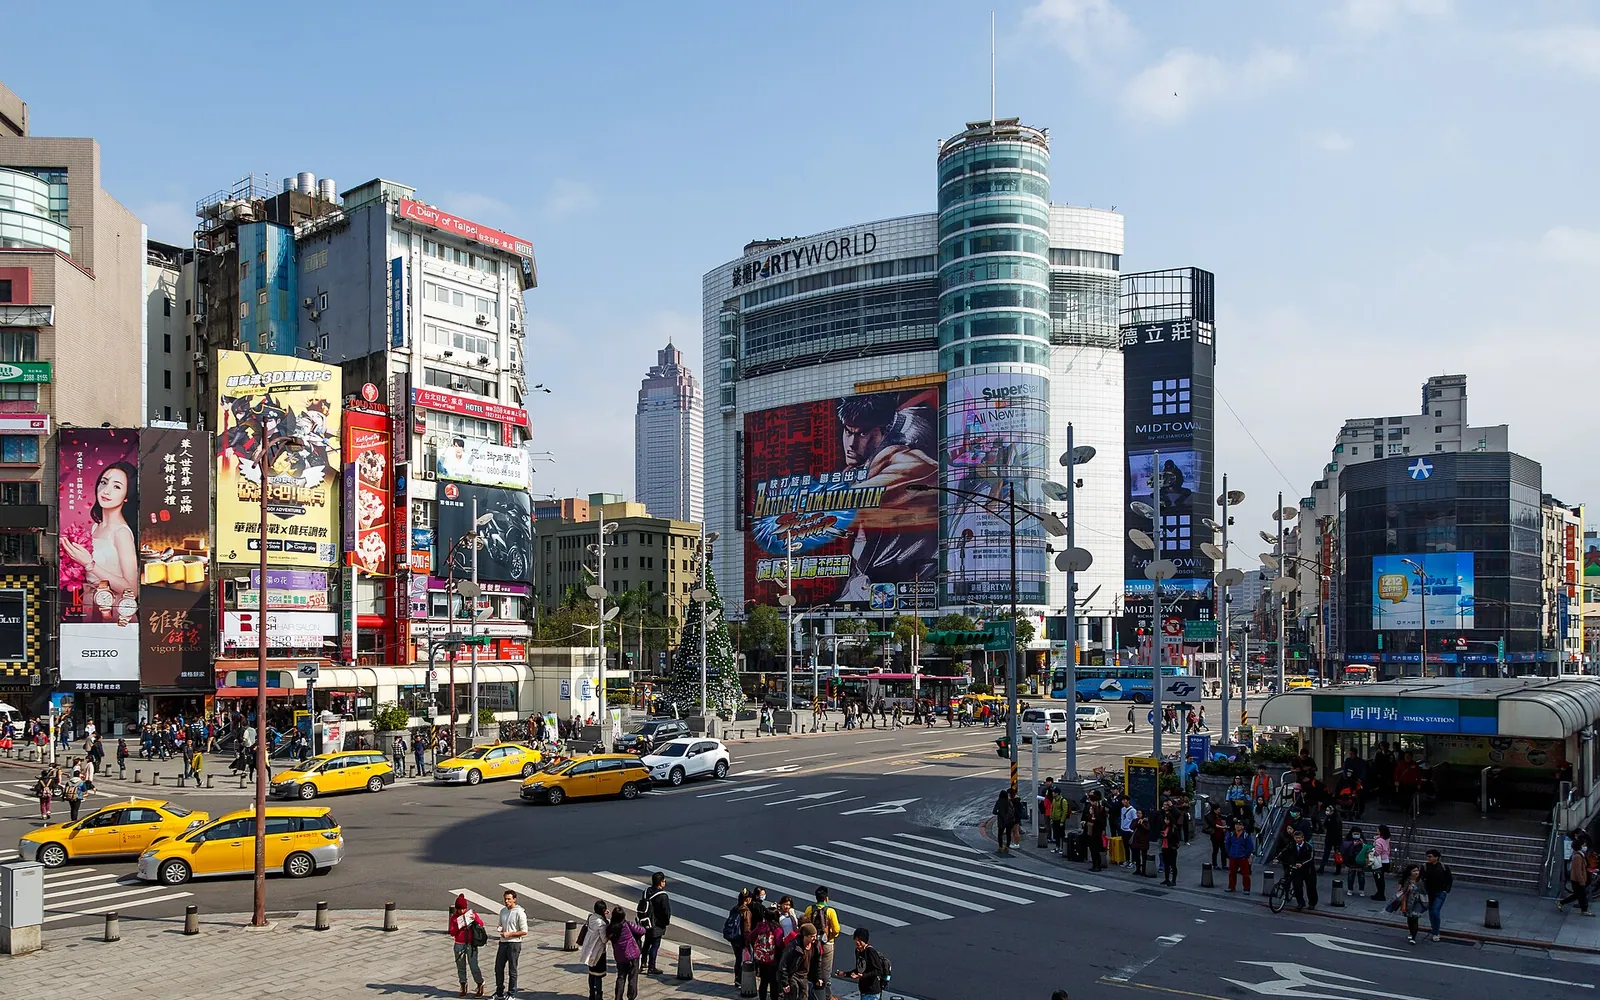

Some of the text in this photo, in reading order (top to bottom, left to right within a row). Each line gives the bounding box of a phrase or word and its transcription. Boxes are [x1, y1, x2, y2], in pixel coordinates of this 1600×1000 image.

[416, 206, 478, 235] Diary of Taipei
[753, 232, 877, 280] PARTYWORLD
[1118, 321, 1192, 346] 德立莊
[465, 403, 484, 413] HOTEL
[973, 413, 987, 427] All
[988, 409, 1015, 423] New
[1135, 421, 1201, 434] MIDTOWN
[179, 438, 194, 515] 華人世界第一品牌
[1381, 577, 1403, 586] 12.12
[267, 595, 282, 603] SPA
[81, 649, 119, 658] SEIKO
[150, 644, 202, 655] vigor kobo
[1350, 706, 1399, 721] 西門站
[1425, 716, 1455, 724] STATION
